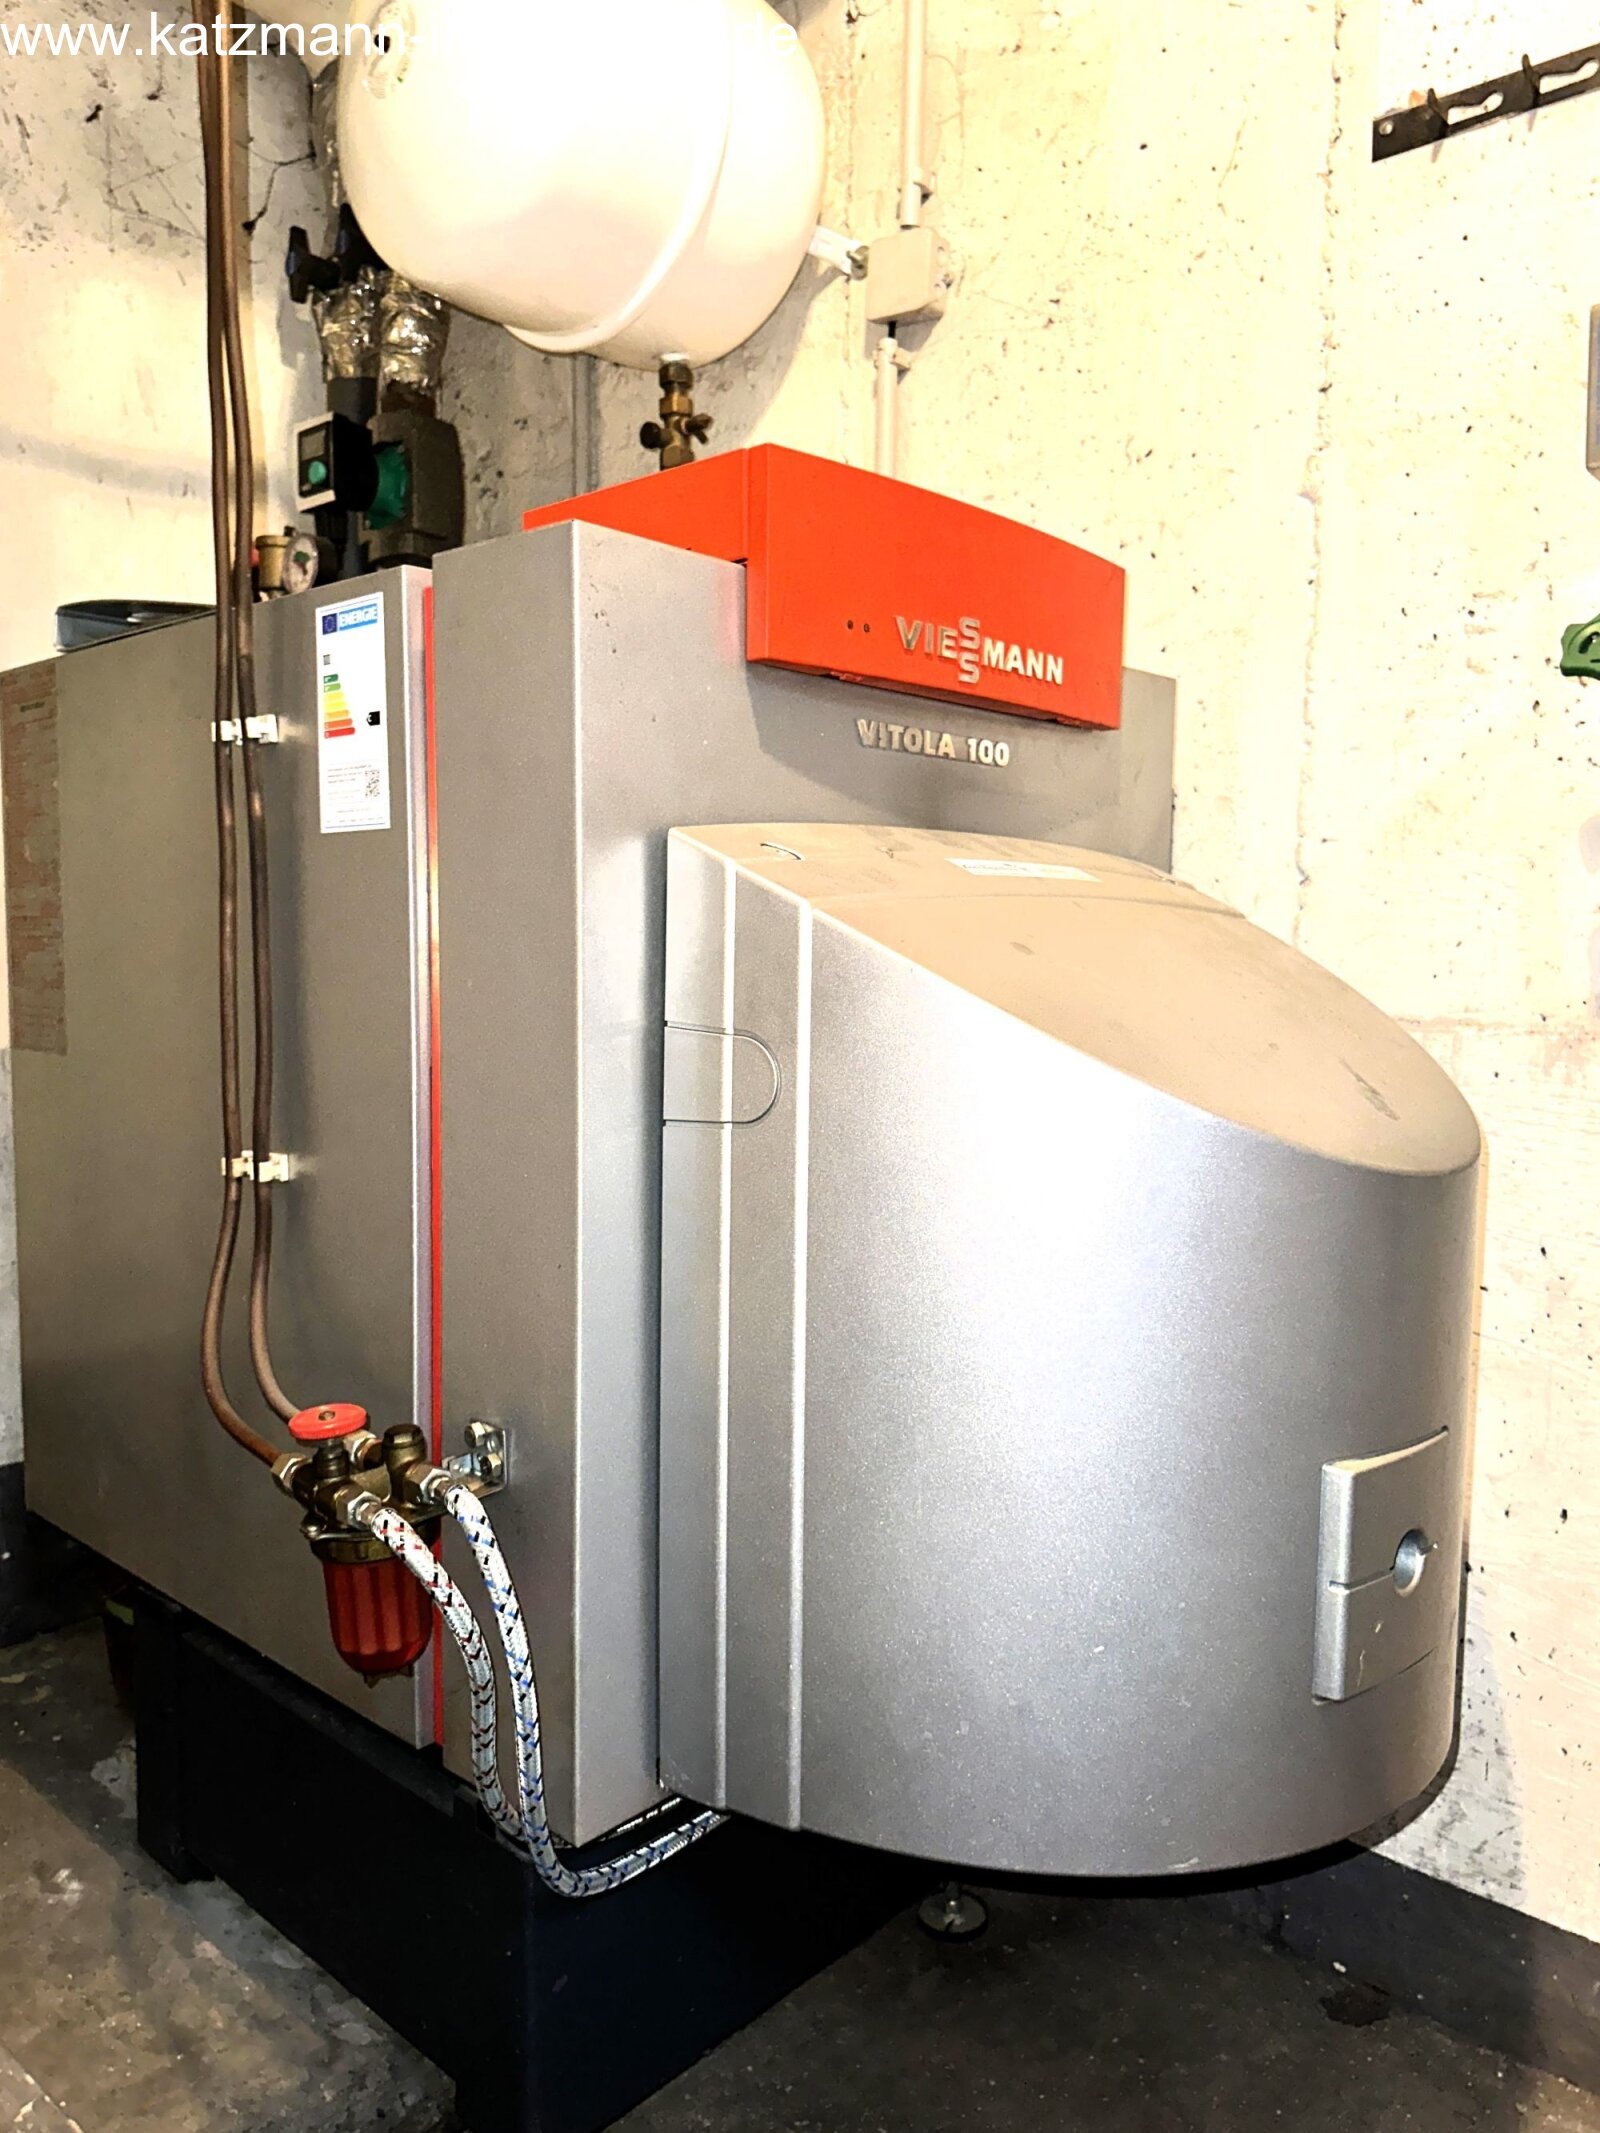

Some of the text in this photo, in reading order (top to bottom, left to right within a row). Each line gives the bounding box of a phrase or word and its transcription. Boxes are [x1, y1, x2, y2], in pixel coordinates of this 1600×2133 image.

[895, 617, 1063, 685] VIESSMANN
[857, 719, 1009, 767] VITOLA 100
